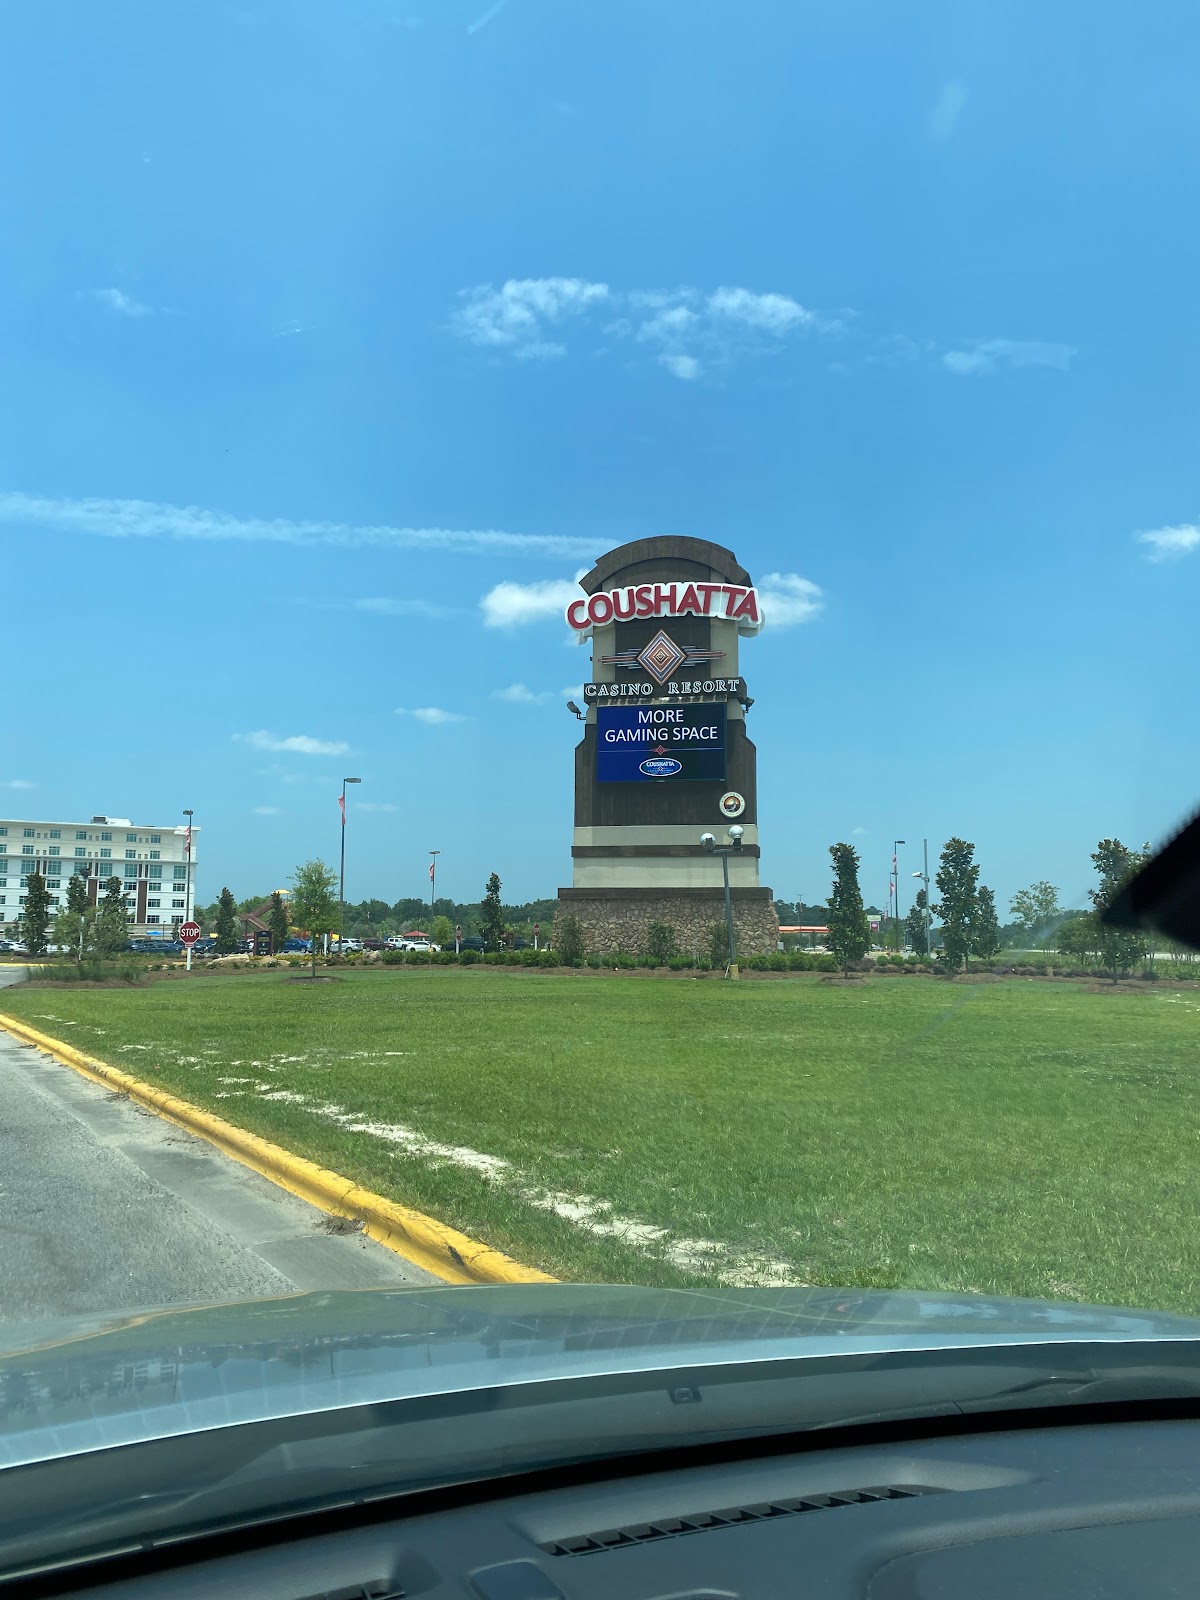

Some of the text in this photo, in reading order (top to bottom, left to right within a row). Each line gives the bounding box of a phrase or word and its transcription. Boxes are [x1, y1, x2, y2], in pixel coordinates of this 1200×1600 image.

[567, 583, 759, 630] COUSHATTA
[585, 678, 740, 697] CASINO RESORT
[638, 709, 684, 724] MORE
[605, 726, 718, 743] GAMING SPACE
[181, 928, 199, 937] STOP
